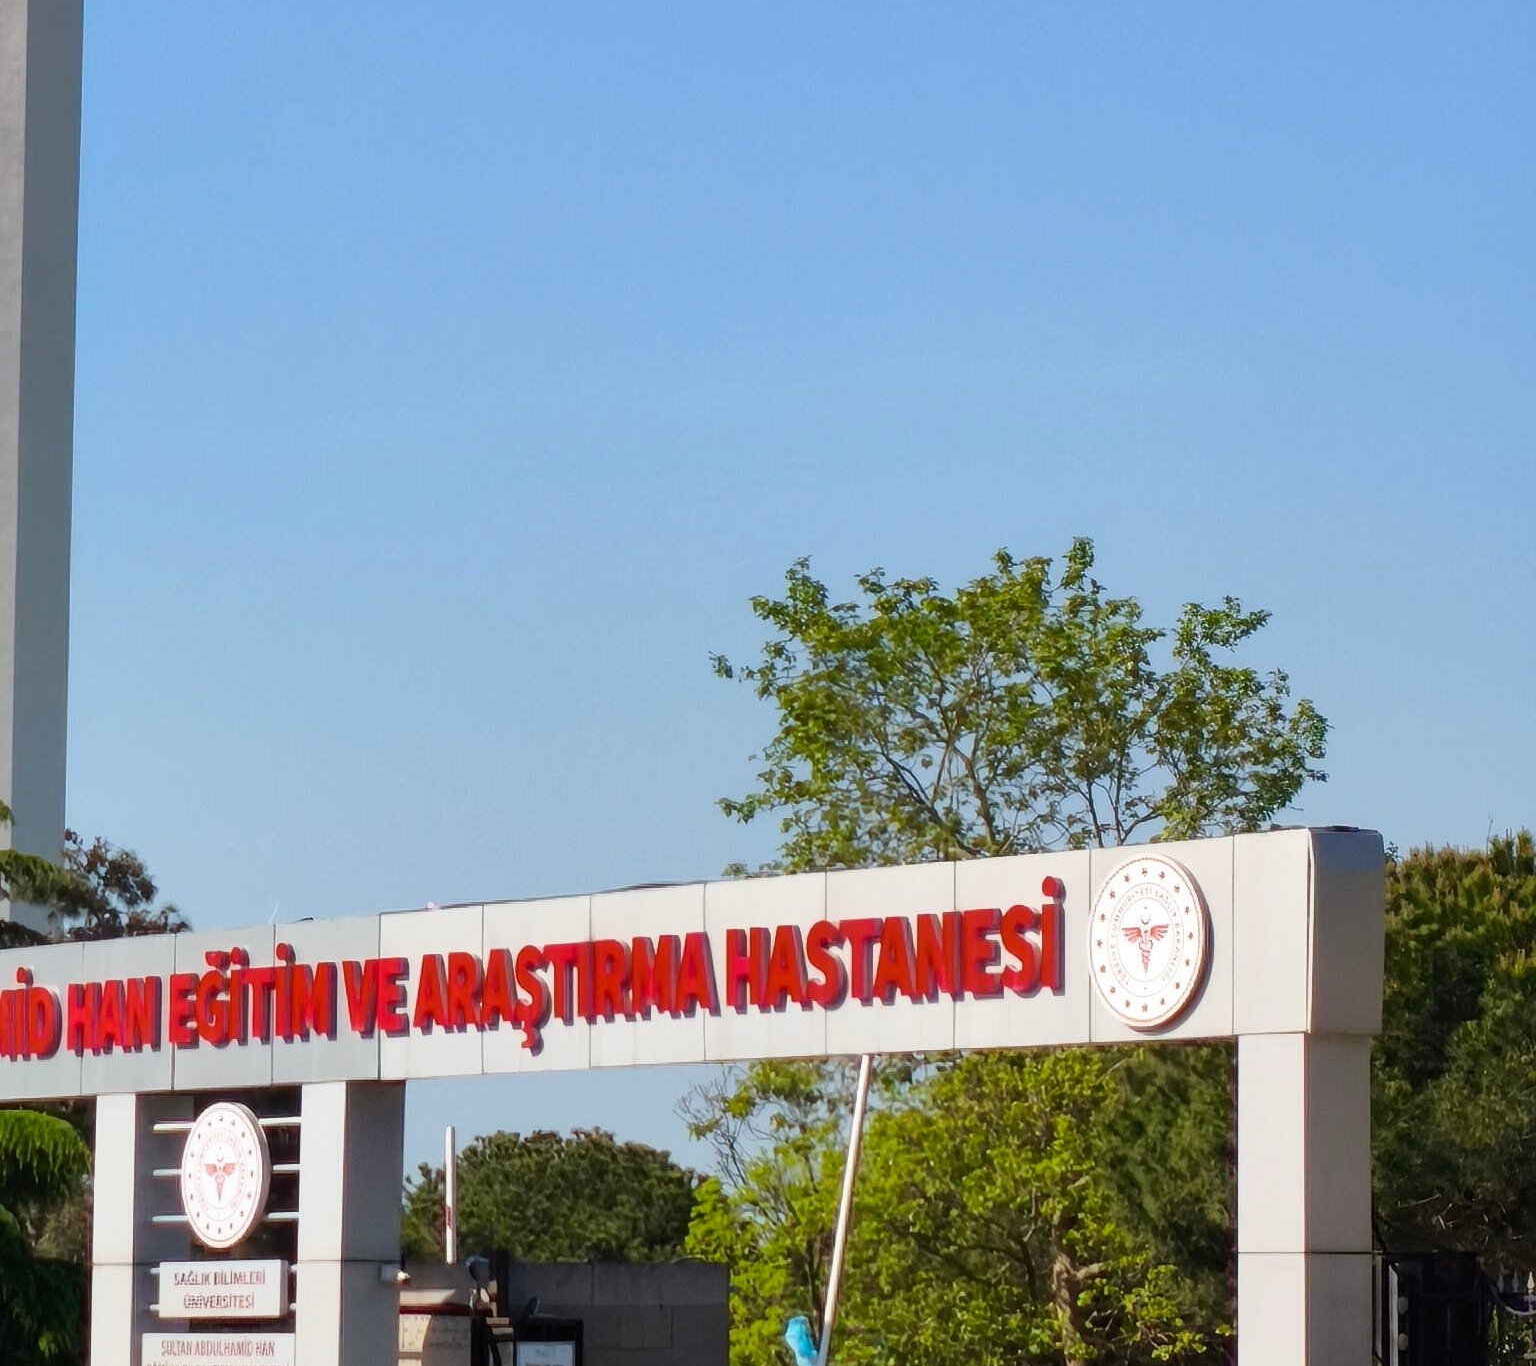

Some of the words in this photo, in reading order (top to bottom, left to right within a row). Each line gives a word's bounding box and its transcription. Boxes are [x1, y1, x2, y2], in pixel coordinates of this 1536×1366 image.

[67, 976, 162, 1055] HAN
[169, 943, 338, 1047] EĞİTİM
[342, 957, 410, 1037] VE
[413, 931, 720, 1055] ARAŞTIRMA
[725, 875, 1066, 1014] HASTANESİ
[174, 1269, 211, 1286] SAĞLIK
[213, 1268, 266, 1285] BİLİMLERİ
[161, 1339, 192, 1356] SULTAN
[255, 1339, 275, 1356] HAN
